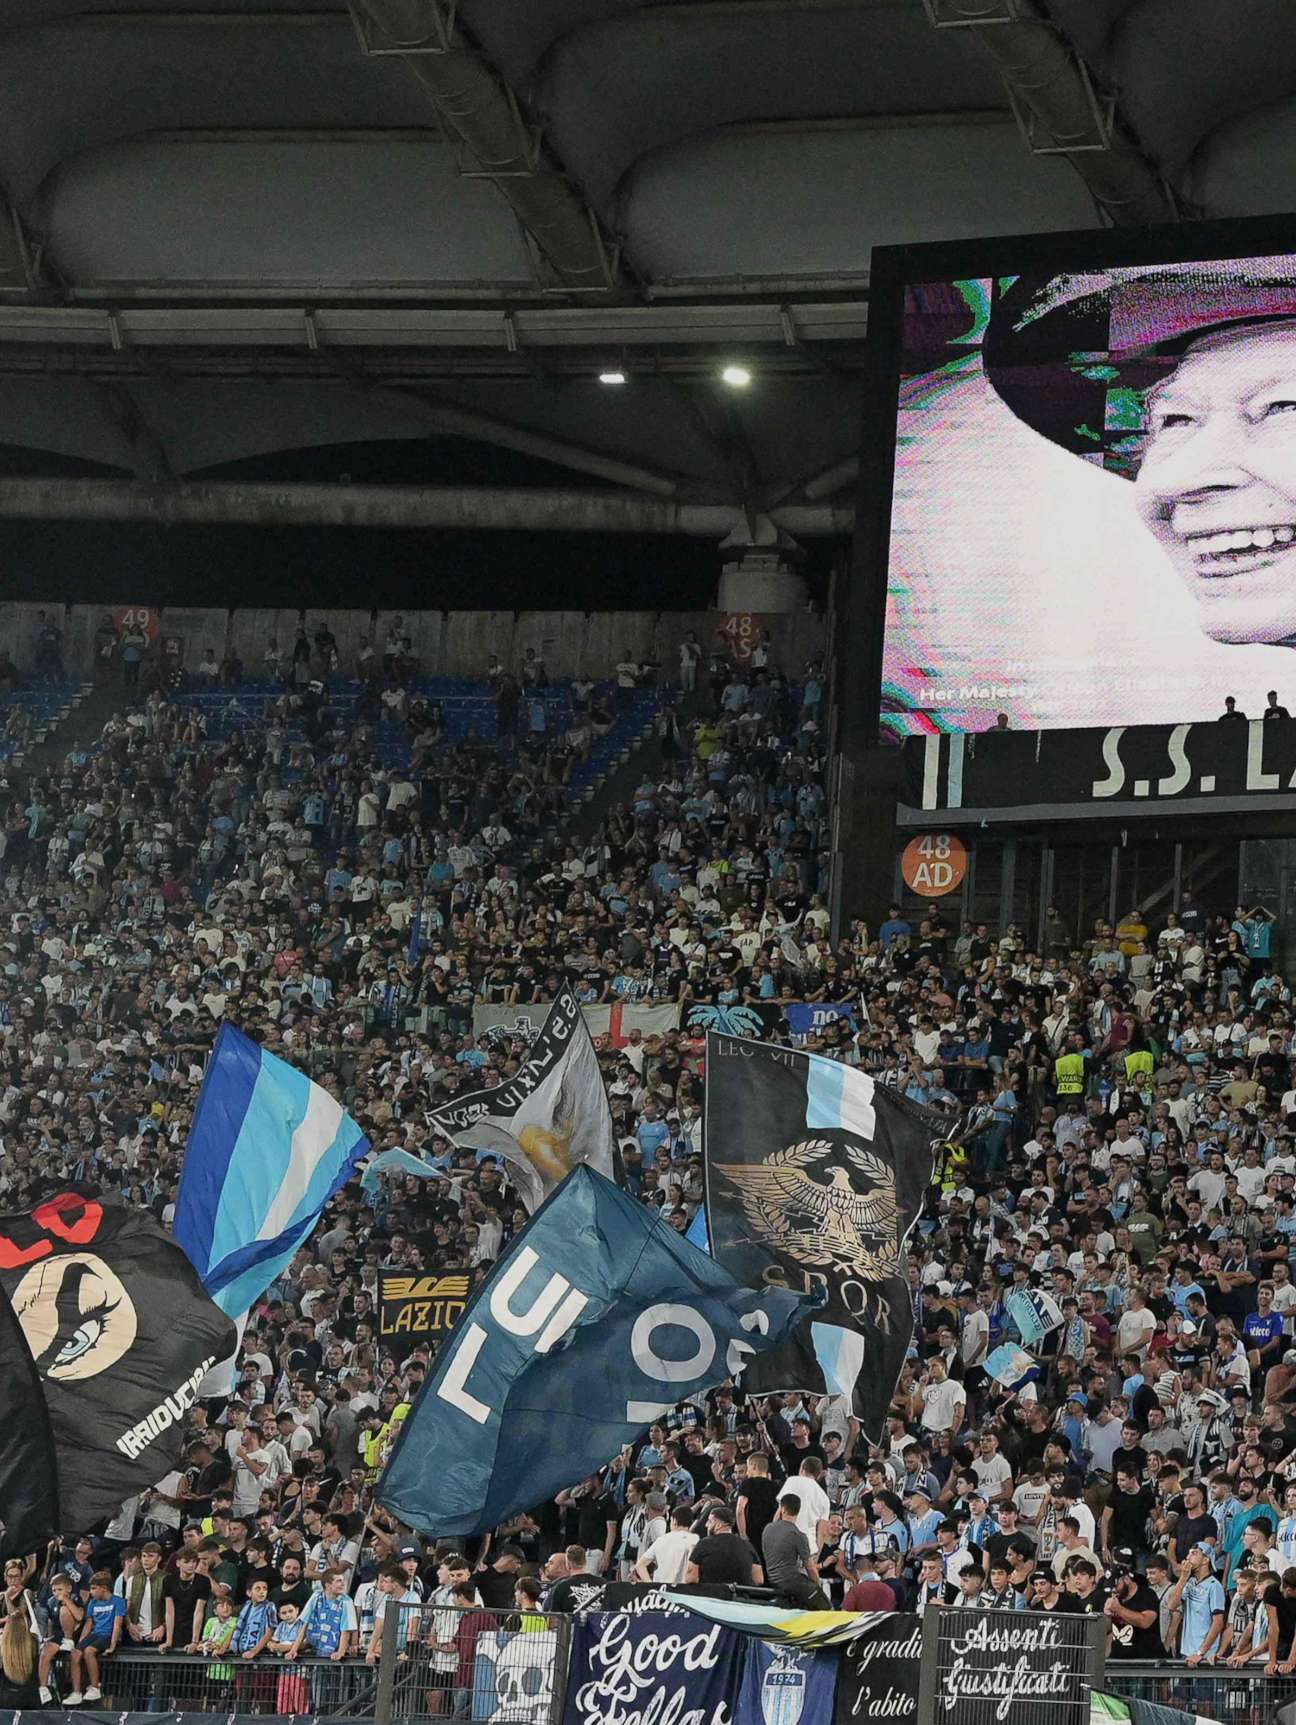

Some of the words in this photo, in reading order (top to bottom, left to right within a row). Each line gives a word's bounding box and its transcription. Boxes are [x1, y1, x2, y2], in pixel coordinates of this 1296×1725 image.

[726, 616, 752, 636] 48
[920, 687, 953, 702] Her
[1092, 724, 1216, 797] S.S.
[918, 835, 951, 860] 48
[912, 862, 953, 888] AD
[381, 1301, 466, 1334] LAZIO
[951, 1617, 1063, 1655] Assenti
[589, 1612, 722, 1695] Good
[771, 1674, 796, 1686] 1974
[942, 1655, 1071, 1721] Giustificati
